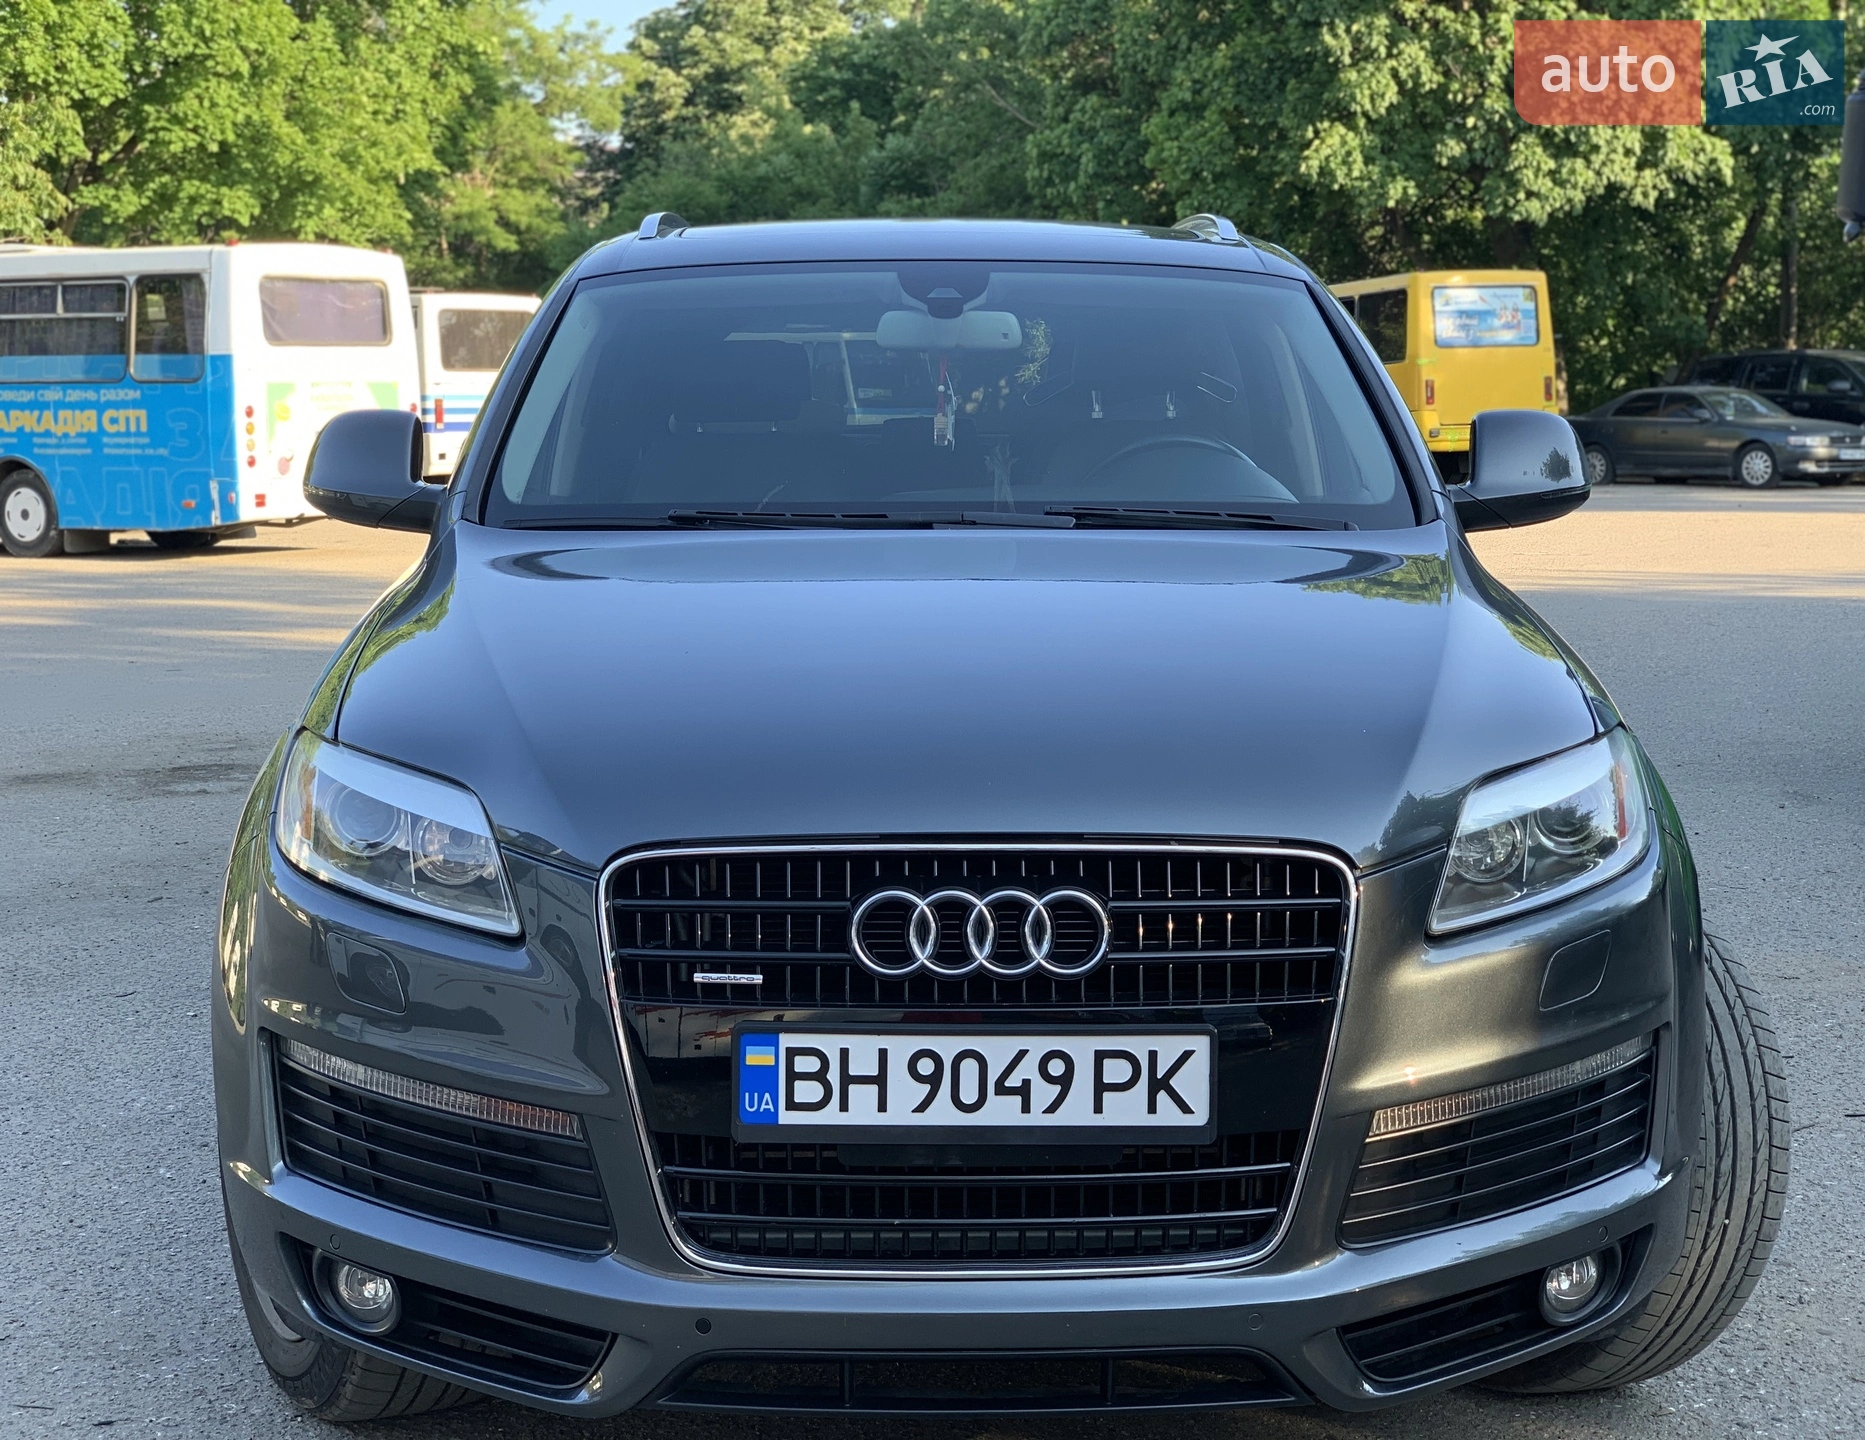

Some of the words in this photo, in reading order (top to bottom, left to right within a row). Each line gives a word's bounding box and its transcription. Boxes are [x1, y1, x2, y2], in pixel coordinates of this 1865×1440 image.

[65, 389, 98, 403] день
[101, 388, 141, 403] разом
[0, 409, 97, 437] АРКАДІЯ
[785, 1046, 888, 1112] BH
[907, 1048, 1075, 1114] 9049
[1093, 1049, 1196, 1114] PK
[744, 1092, 775, 1112] UA
